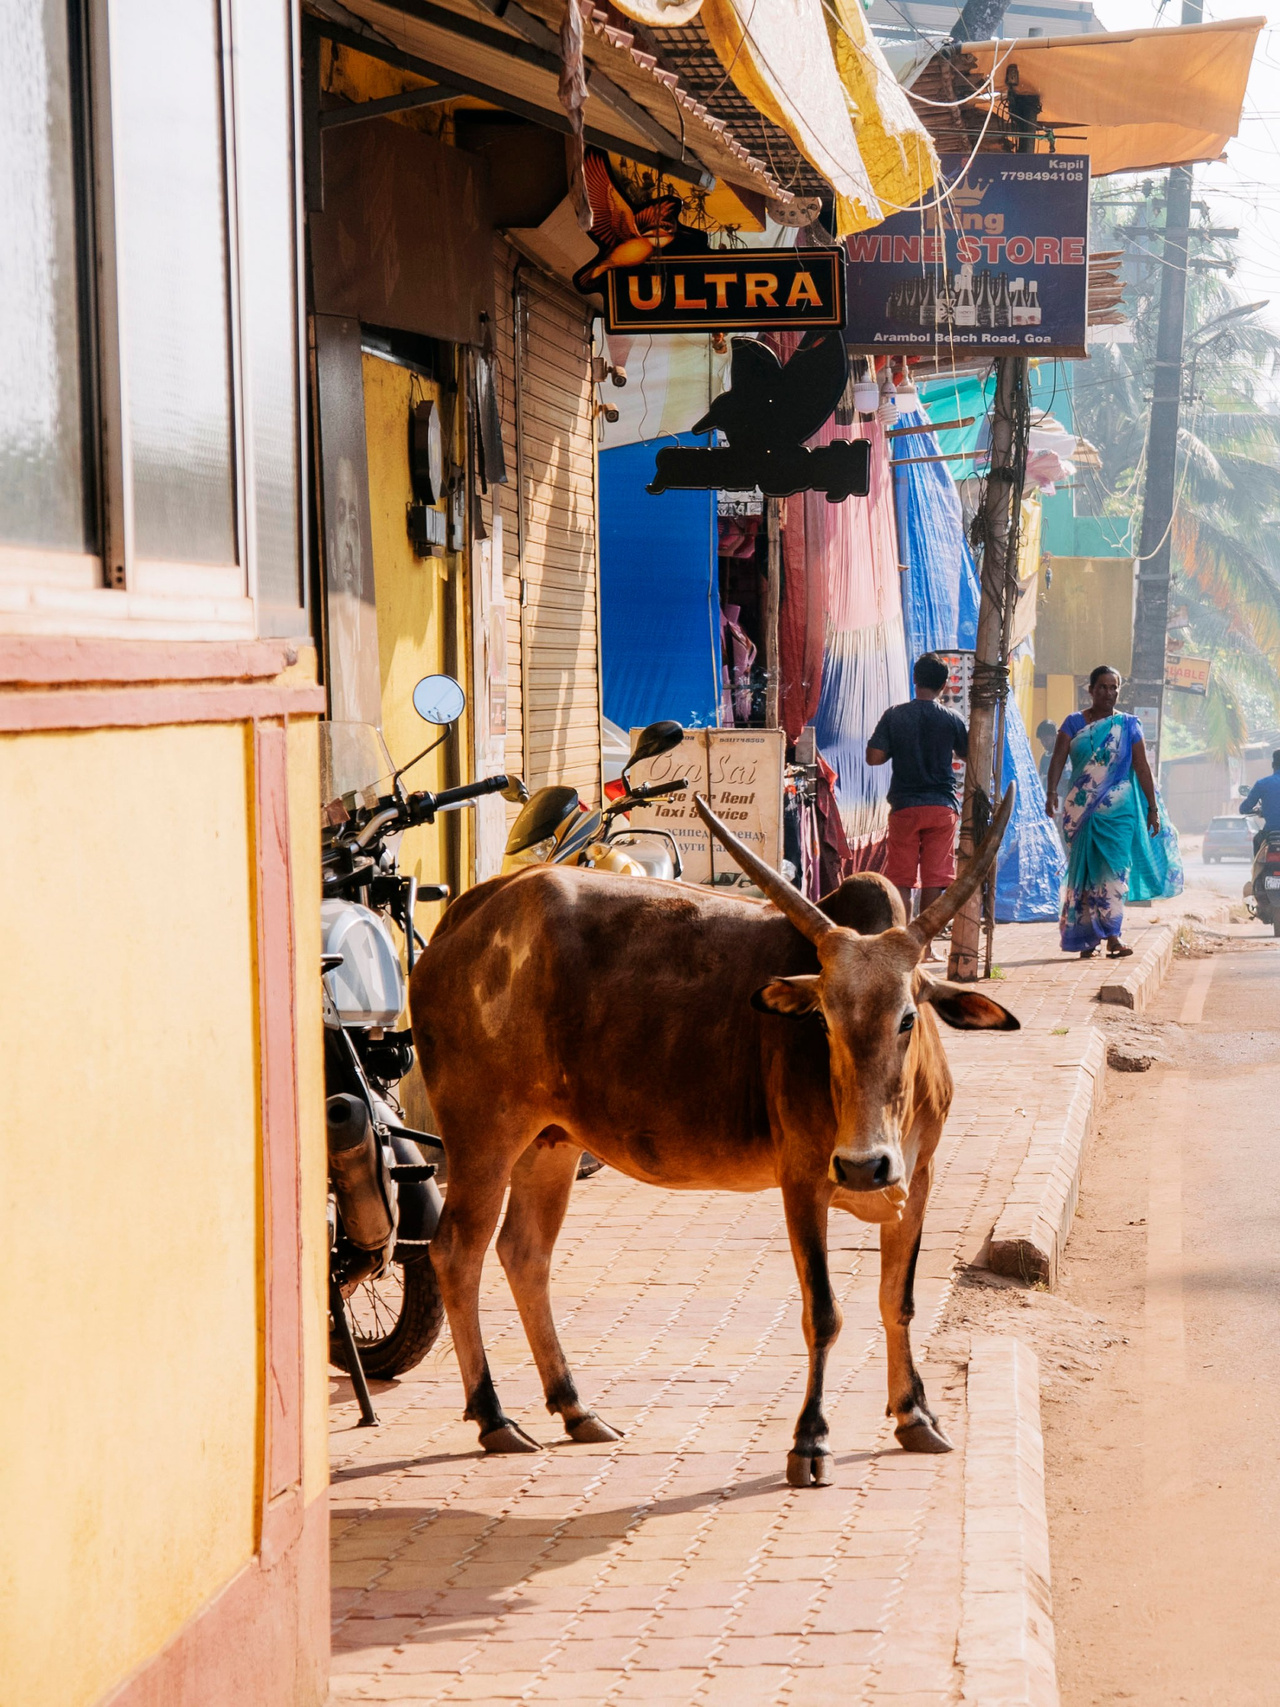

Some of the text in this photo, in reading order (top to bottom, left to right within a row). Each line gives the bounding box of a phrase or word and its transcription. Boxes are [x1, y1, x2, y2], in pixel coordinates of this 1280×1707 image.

[1049, 159, 1084, 171] Kapil
[1000, 172, 1084, 181] 7798494108
[926, 207, 1005, 235] King
[846, 235, 1085, 265] WINE STORE
[627, 271, 824, 311] ULTRA
[873, 332, 1052, 345] Arambol Beach Road, Goa
[649, 753, 758, 785] Om Sai
[720, 791, 756, 805] Rent
[654, 804, 686, 818] Taxi
